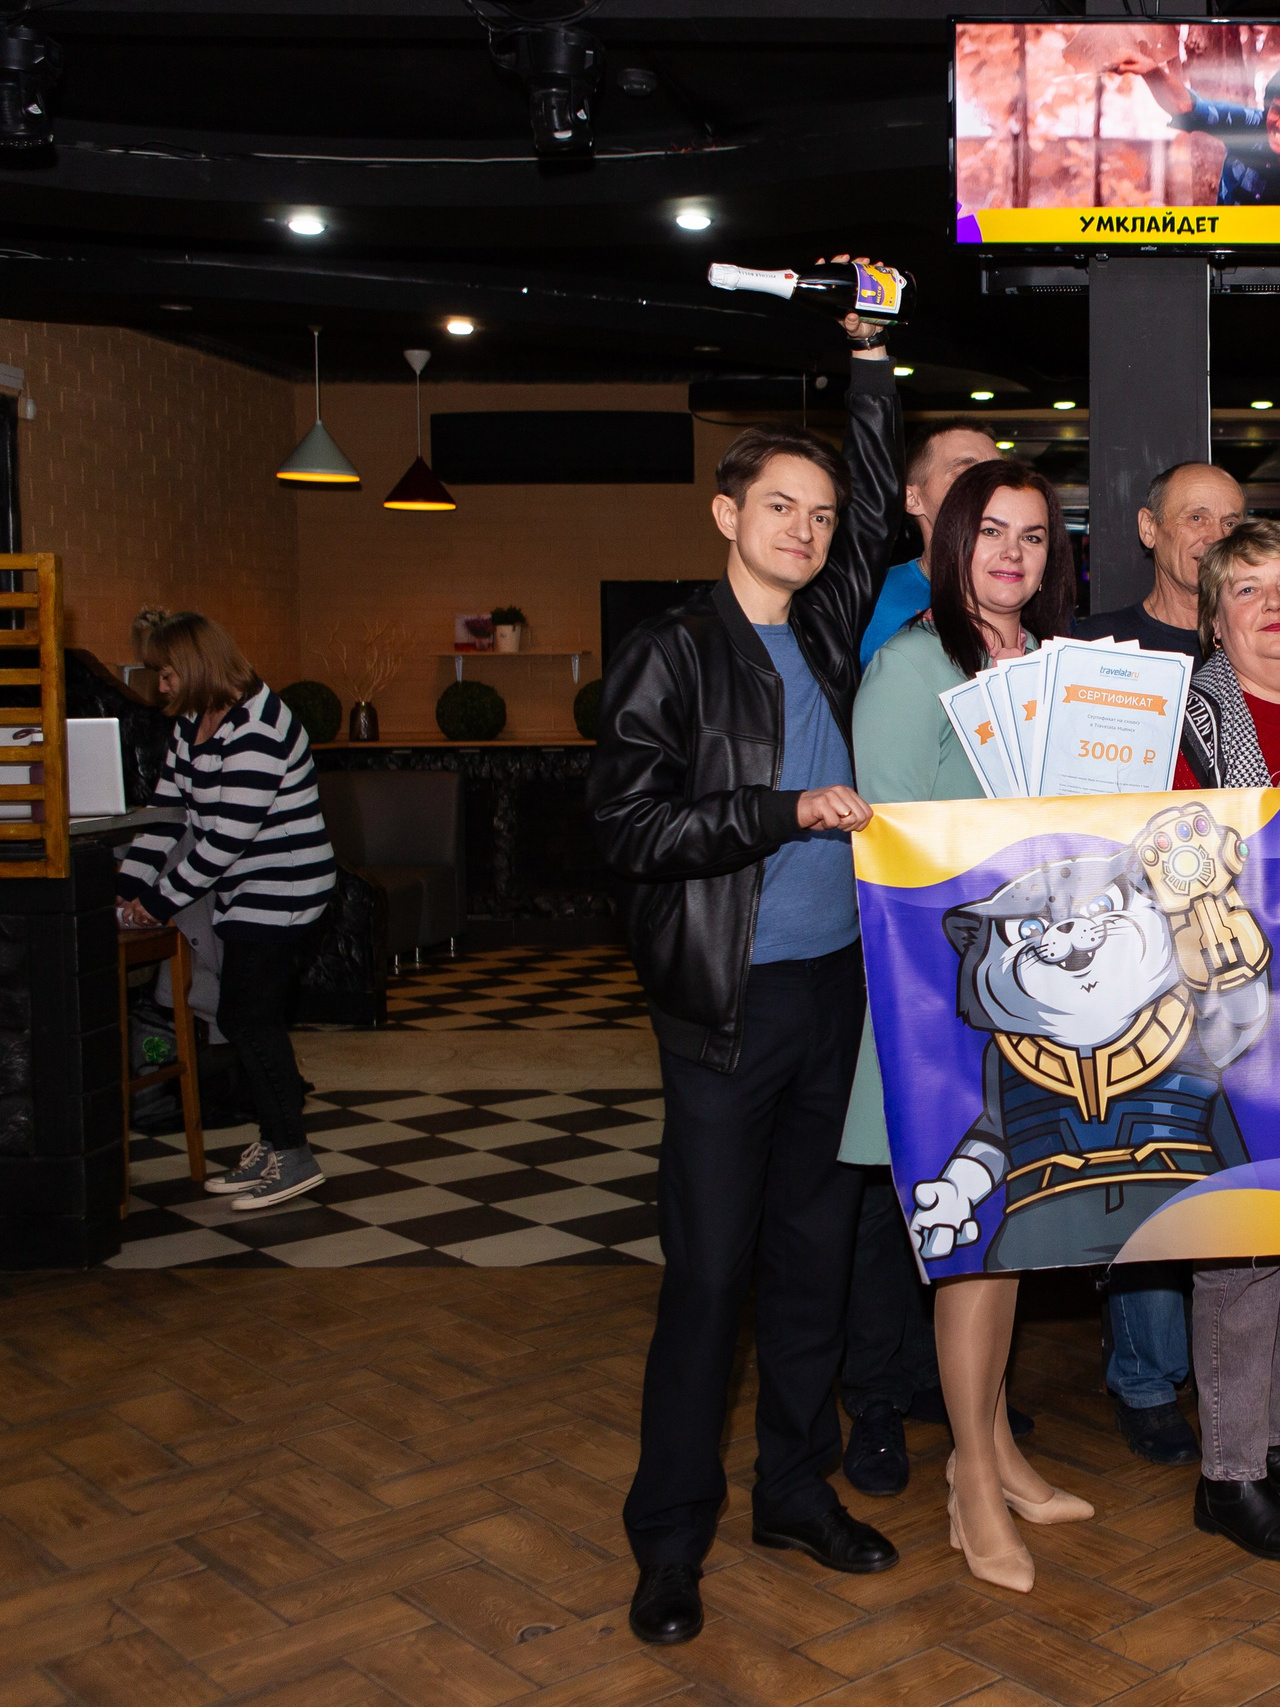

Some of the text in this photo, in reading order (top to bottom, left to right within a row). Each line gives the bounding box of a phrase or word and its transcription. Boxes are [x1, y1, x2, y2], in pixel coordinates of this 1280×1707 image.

[1079, 212, 1220, 235] УМКЛАЙДЕТ
[861, 289, 876, 298] 1
[1078, 689, 1154, 708] СЕРТИФИКАТ
[1077, 739, 1133, 764] 3000
